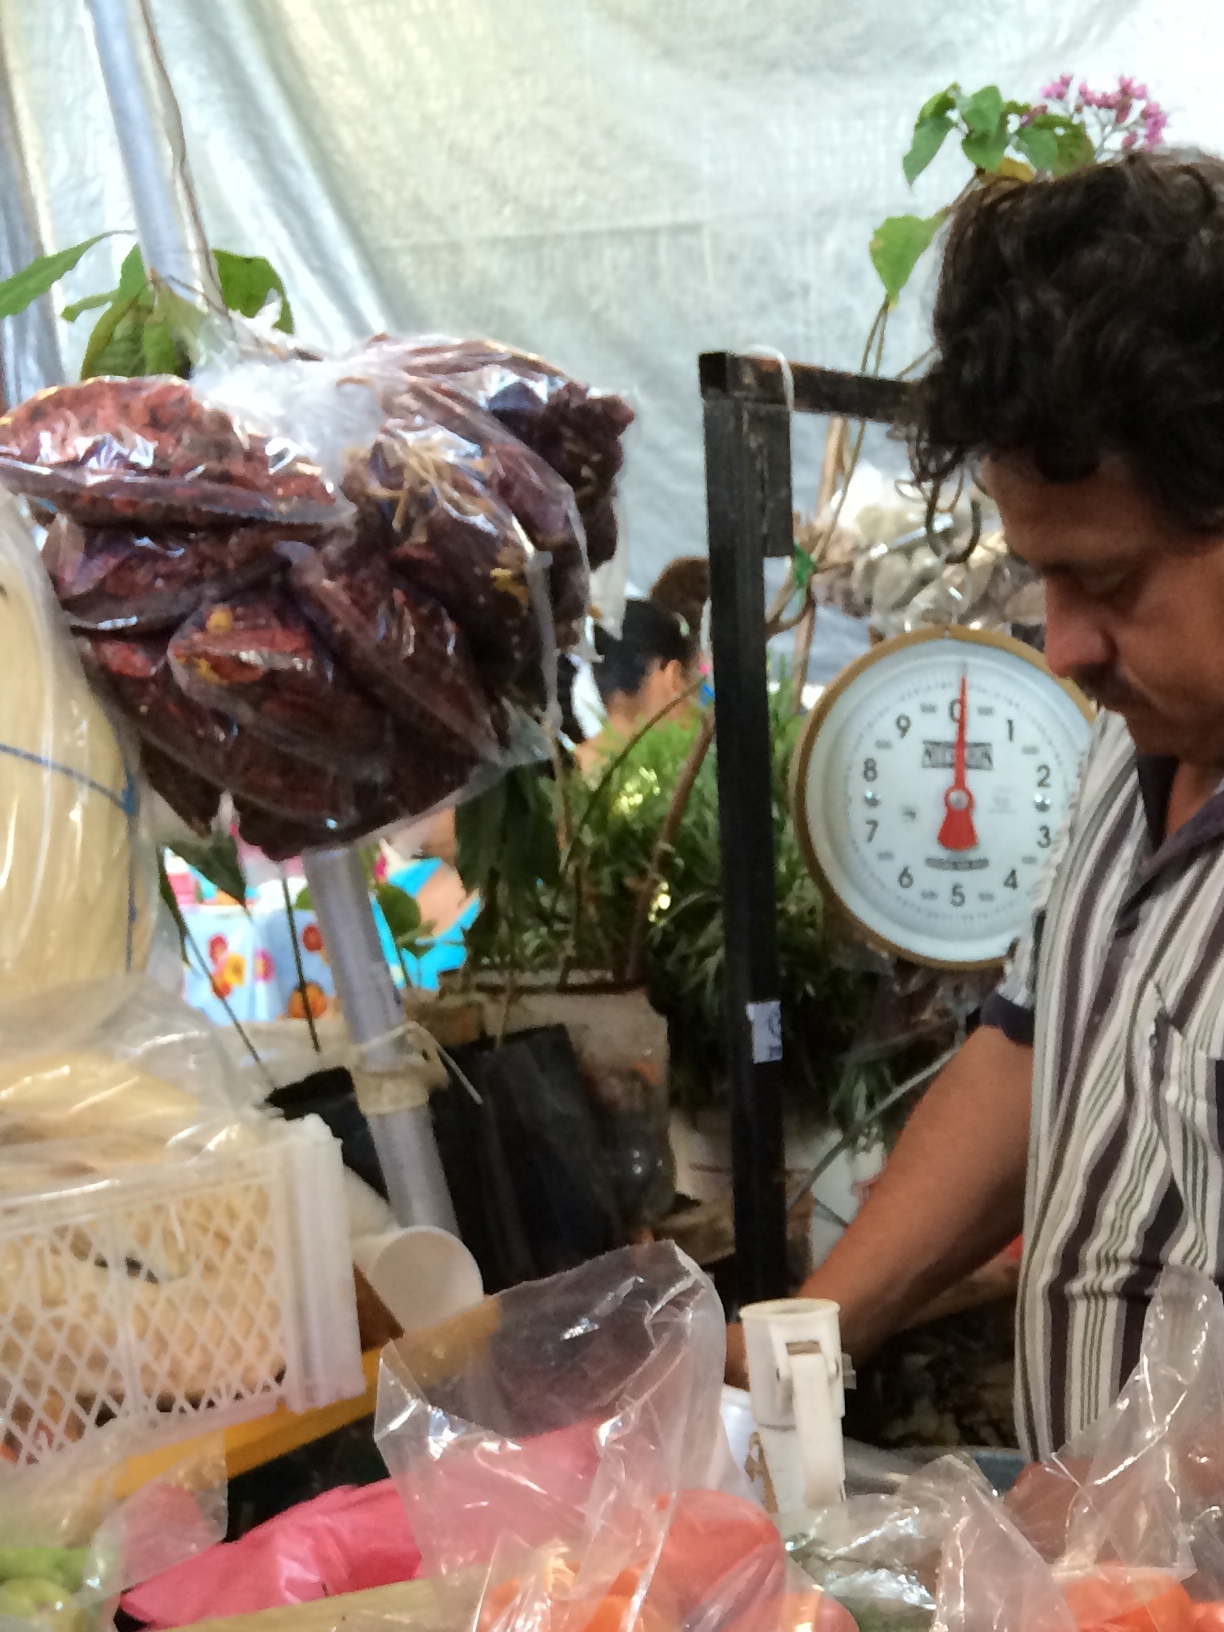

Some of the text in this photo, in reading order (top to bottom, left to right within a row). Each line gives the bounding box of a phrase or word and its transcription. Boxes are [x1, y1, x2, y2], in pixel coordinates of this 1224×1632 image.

[895, 714, 911, 738] 9
[1007, 718, 1015, 742] 1
[863, 757, 878, 782] 8
[1037, 764, 1051, 788] 2
[865, 819, 879, 842] 7
[1037, 825, 1051, 848] 3
[898, 865, 914, 889] 6
[1003, 868, 1018, 889] 4
[950, 883, 965, 907] 5
